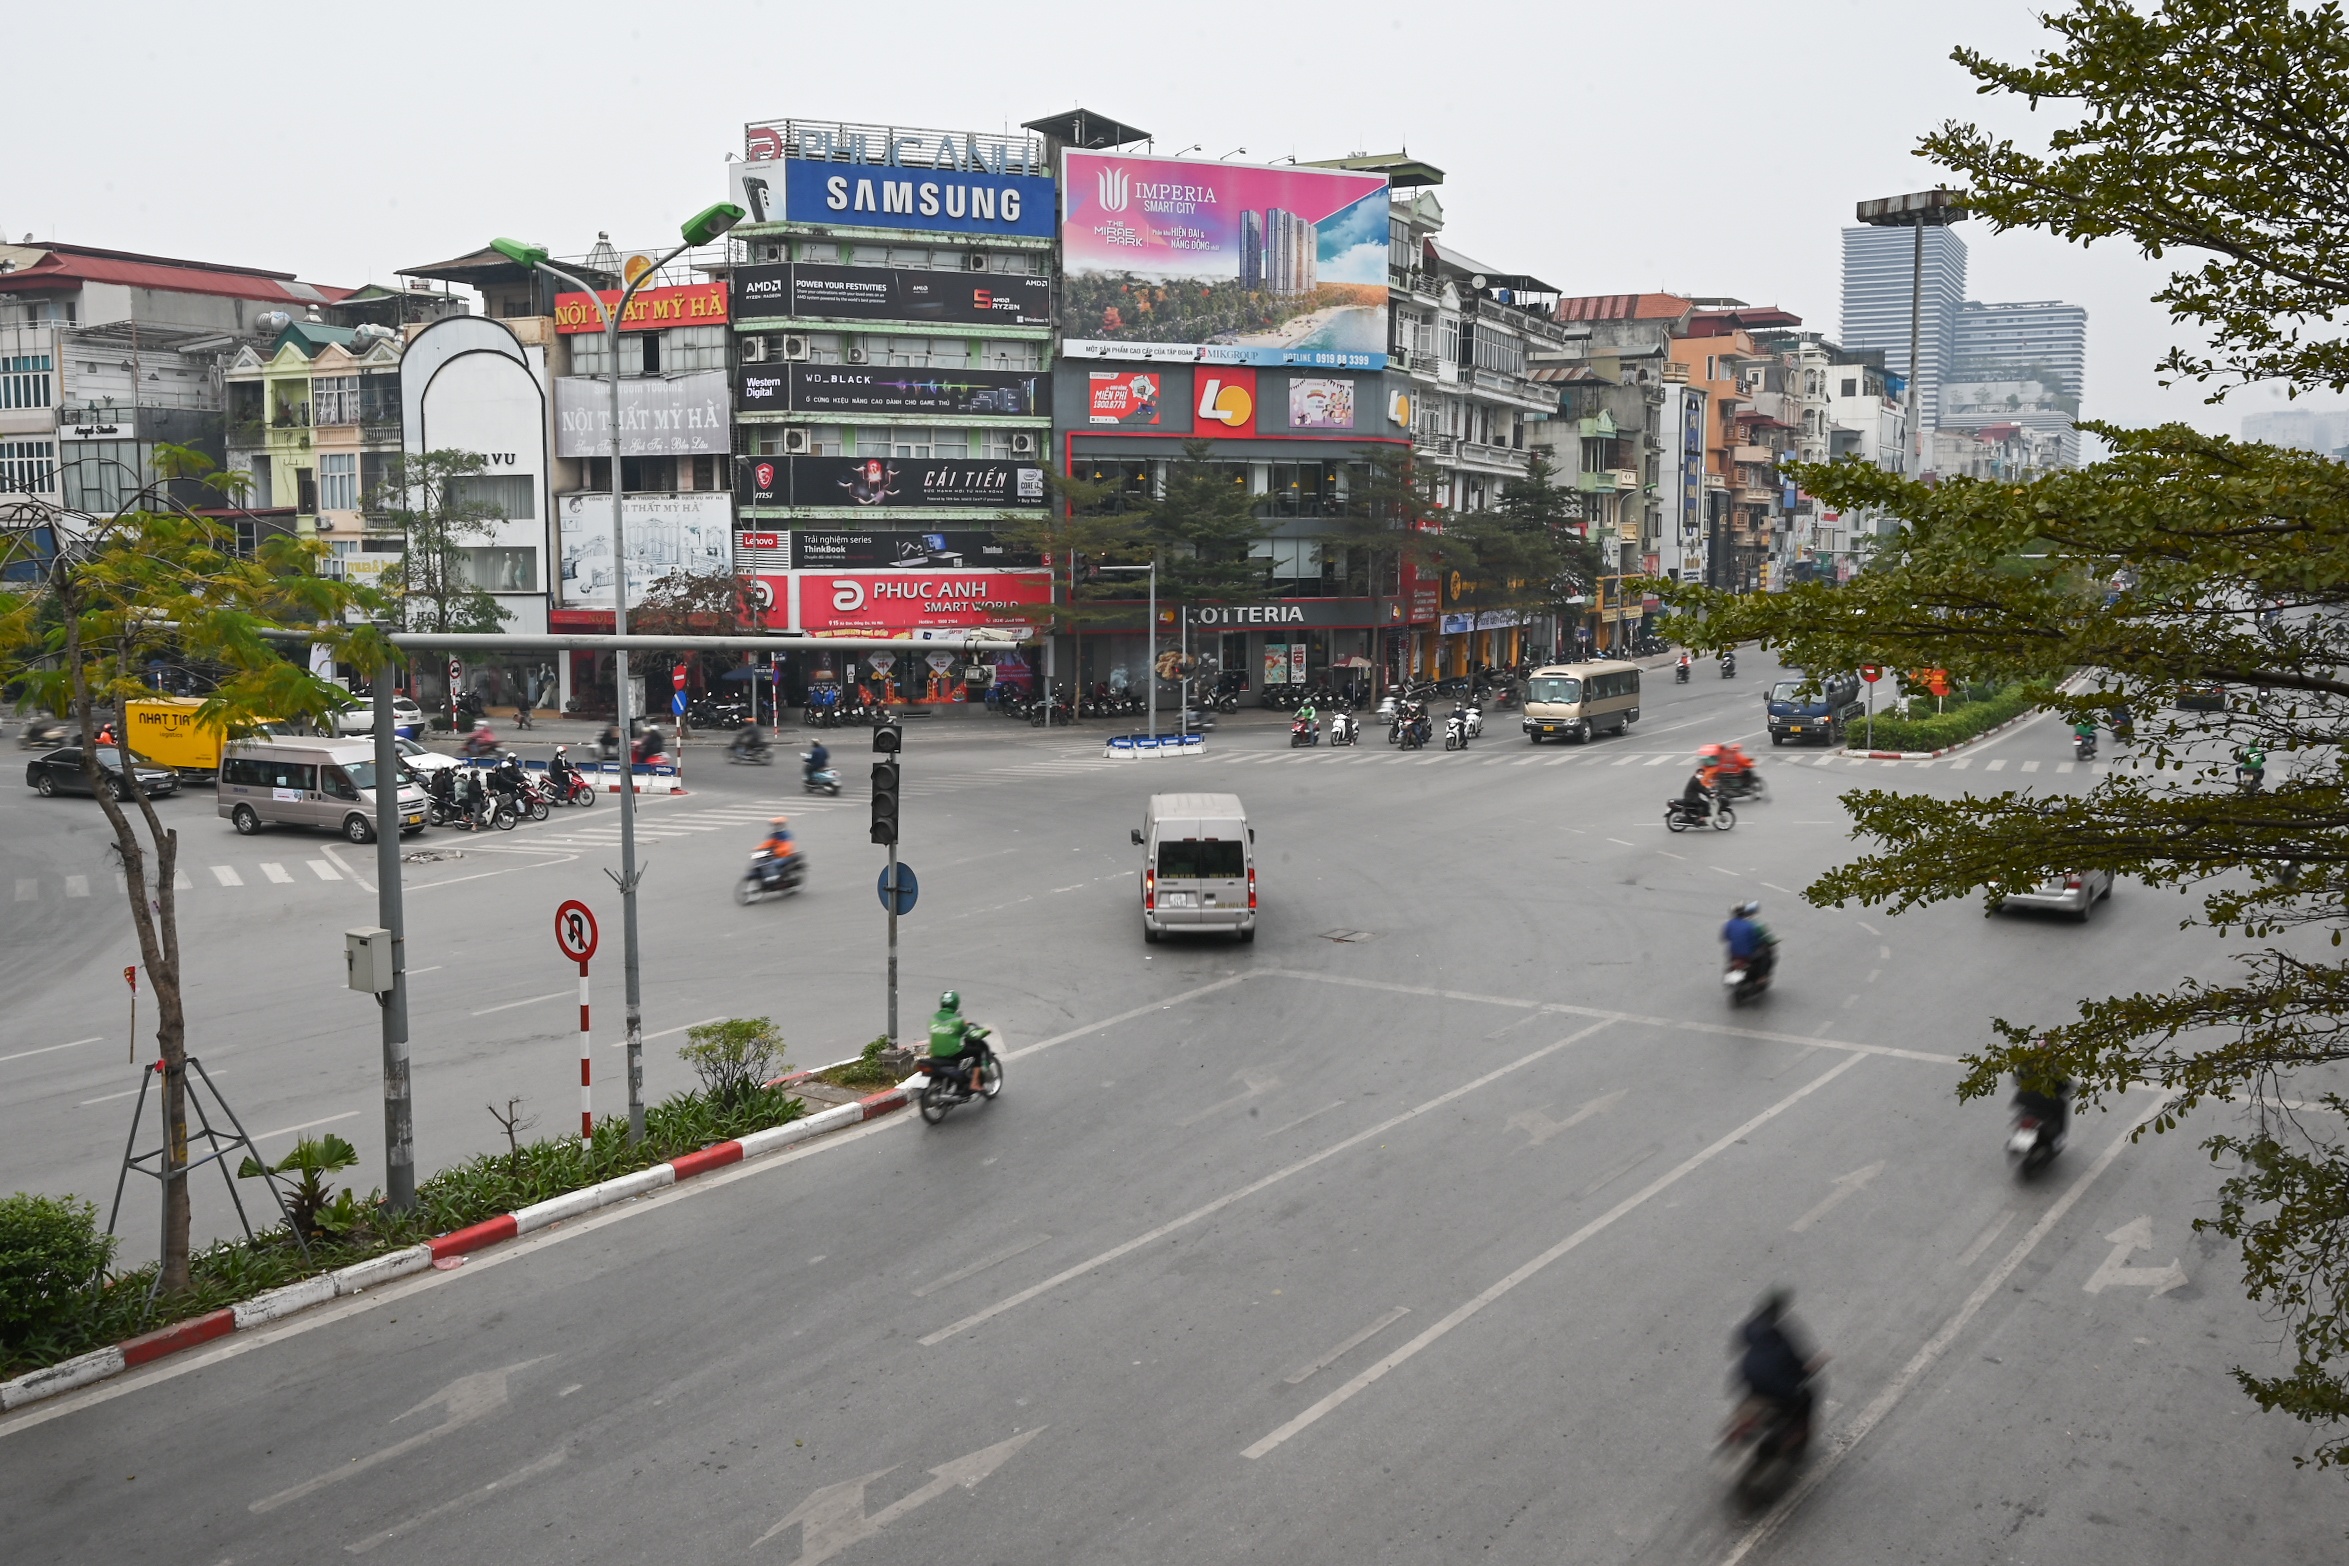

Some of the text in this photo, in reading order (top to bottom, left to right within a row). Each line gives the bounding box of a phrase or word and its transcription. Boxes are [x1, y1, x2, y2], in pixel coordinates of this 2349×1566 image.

[799, 129, 1030, 176] PHUC ANH
[826, 175, 1022, 222] SAMSUNG
[1135, 182, 1217, 203] IMPERIA
[1144, 200, 1196, 214] SMART CITY
[1094, 226, 1136, 237] MIRAE
[1106, 236, 1143, 247] PARK
[746, 280, 773, 293] AMD
[796, 280, 887, 292] POWER YOUR FESTIVITIES
[555, 300, 588, 330] NỘI
[653, 293, 685, 320] MỸ
[690, 289, 725, 317] HÀ
[992, 303, 1020, 311] RYZEN
[1207, 350, 1259, 360] MIKGROUP
[1282, 353, 1369, 365] HOTLINE 0919 88 3399
[746, 377, 781, 387] Western
[594, 383, 643, 394] Shoroom
[746, 387, 773, 399] Digital
[1094, 386, 1128, 400] MIỄN PHÍ
[562, 398, 719, 436] NỘI TẤT MỸ HÀ
[923, 466, 1007, 488] CẢI TIẾN
[1020, 481, 1033, 489] CORE
[755, 491, 773, 499] msi
[631, 501, 661, 512] THẤT
[663, 502, 680, 512] MỸ
[682, 501, 701, 512] HÀ
[745, 536, 774, 545] Lenovo
[804, 535, 872, 546] Trải nghiệm series
[804, 545, 846, 553] ThinkBook
[873, 582, 987, 599] PHUC ANH
[924, 602, 969, 613] SMART
[1188, 606, 1305, 624] OTTERIA
